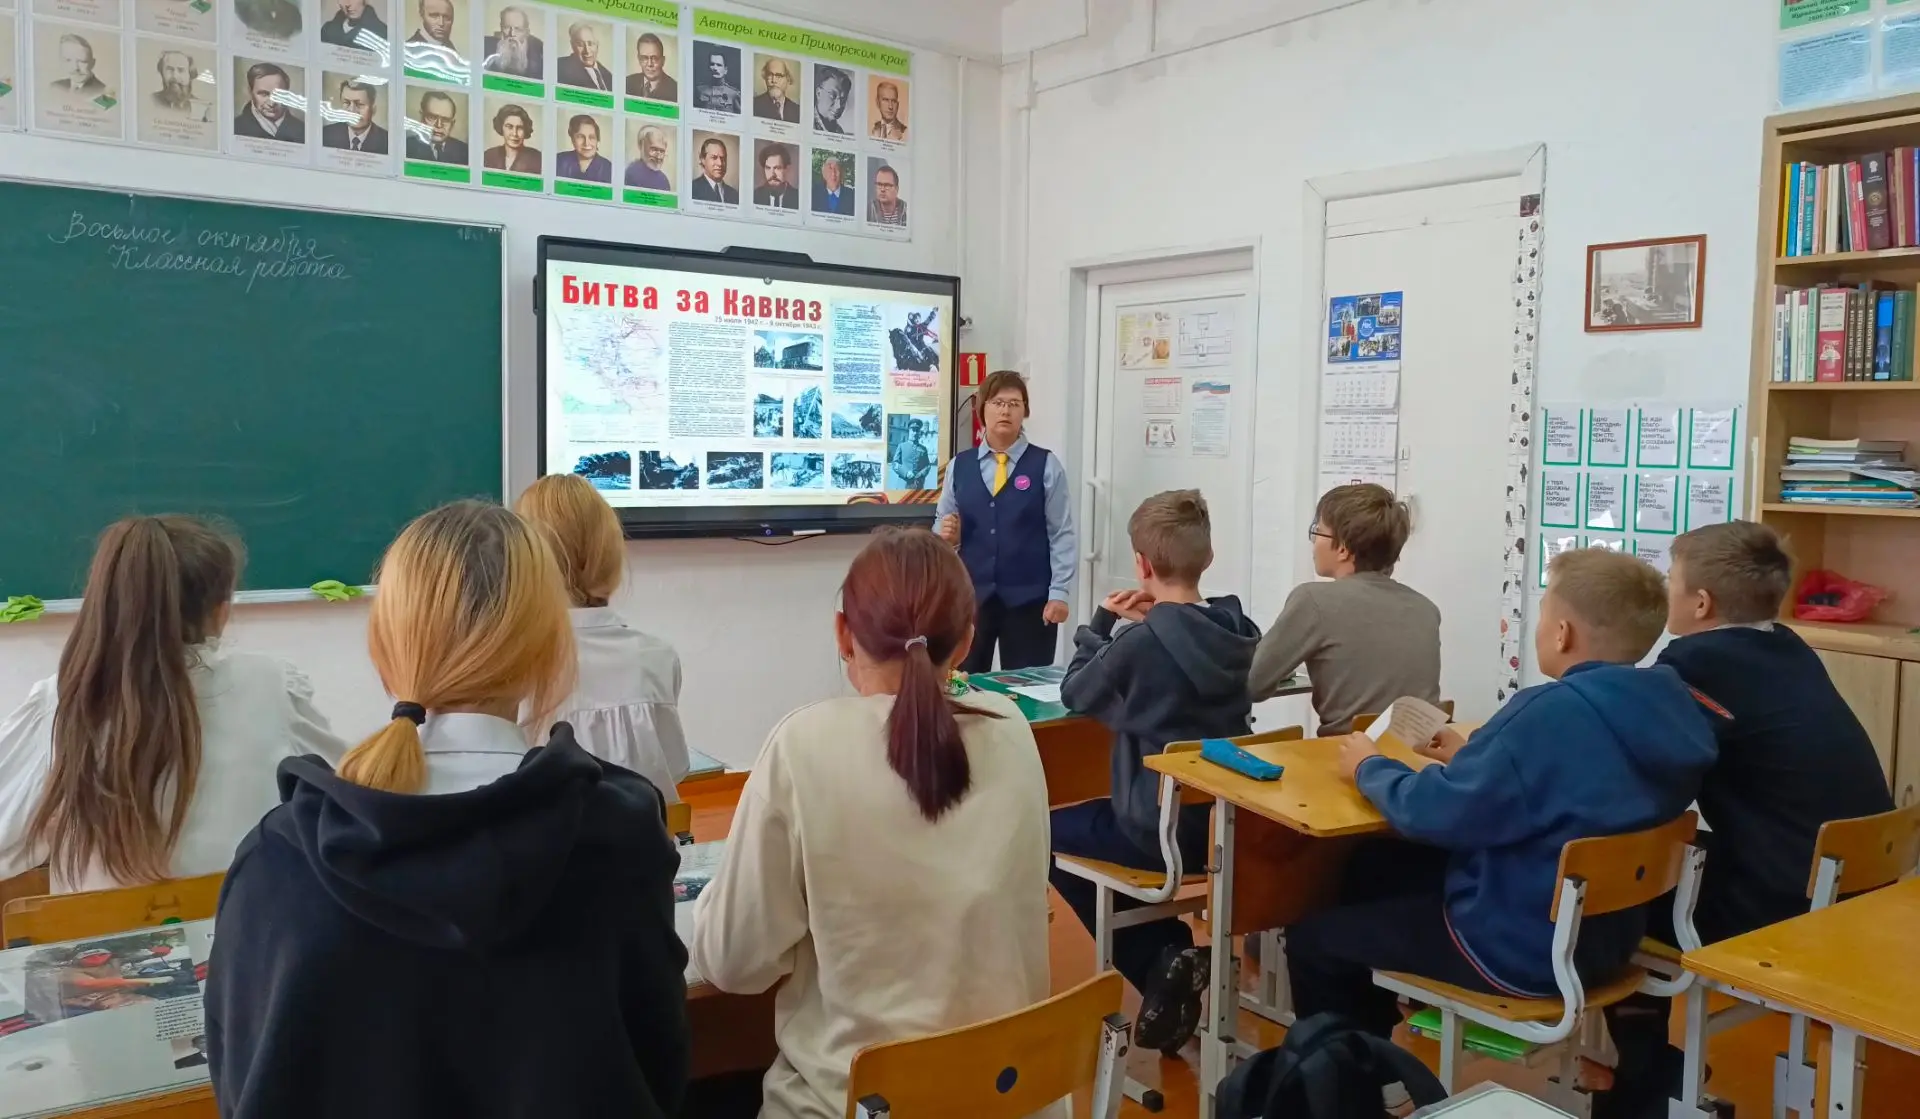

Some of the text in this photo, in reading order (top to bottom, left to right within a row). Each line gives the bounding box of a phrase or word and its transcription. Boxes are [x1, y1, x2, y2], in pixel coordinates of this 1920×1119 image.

[699, 15, 908, 67] Авторы книг о Приморском крае
[48, 210, 335, 261] Восьмое октября
[108, 243, 352, 294] Классная работа
[562, 275, 822, 322] Битва за Кавказ
